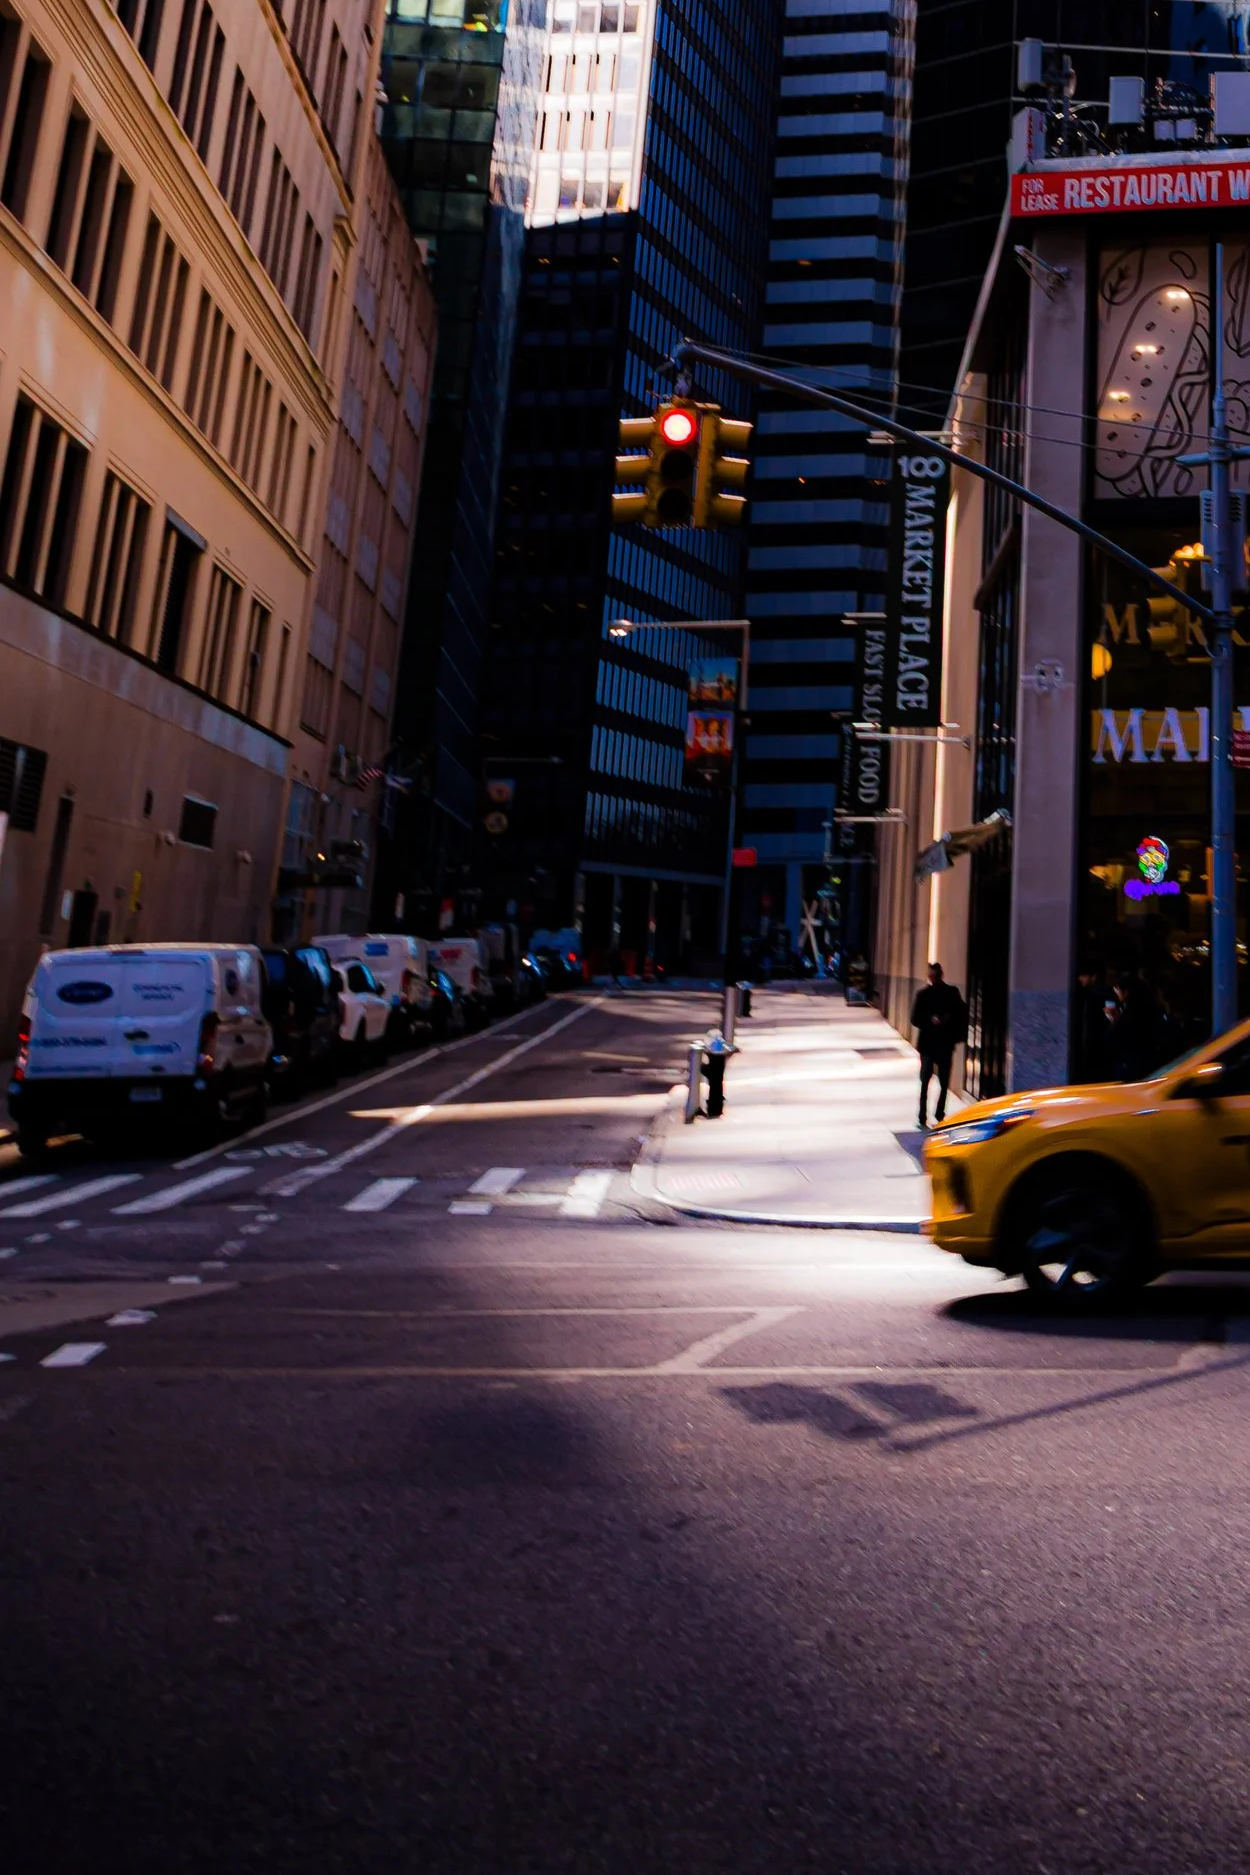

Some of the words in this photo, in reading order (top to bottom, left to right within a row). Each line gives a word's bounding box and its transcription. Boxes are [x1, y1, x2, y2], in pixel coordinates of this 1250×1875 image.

[1021, 178, 1044, 194] FOR
[1021, 194, 1059, 212] LEASE
[1064, 171, 1222, 208] RESTAURANT
[901, 484, 936, 611] MARKET
[863, 629, 886, 680] FAST
[896, 616, 932, 711] PLACE
[857, 745, 881, 804] FOOD
